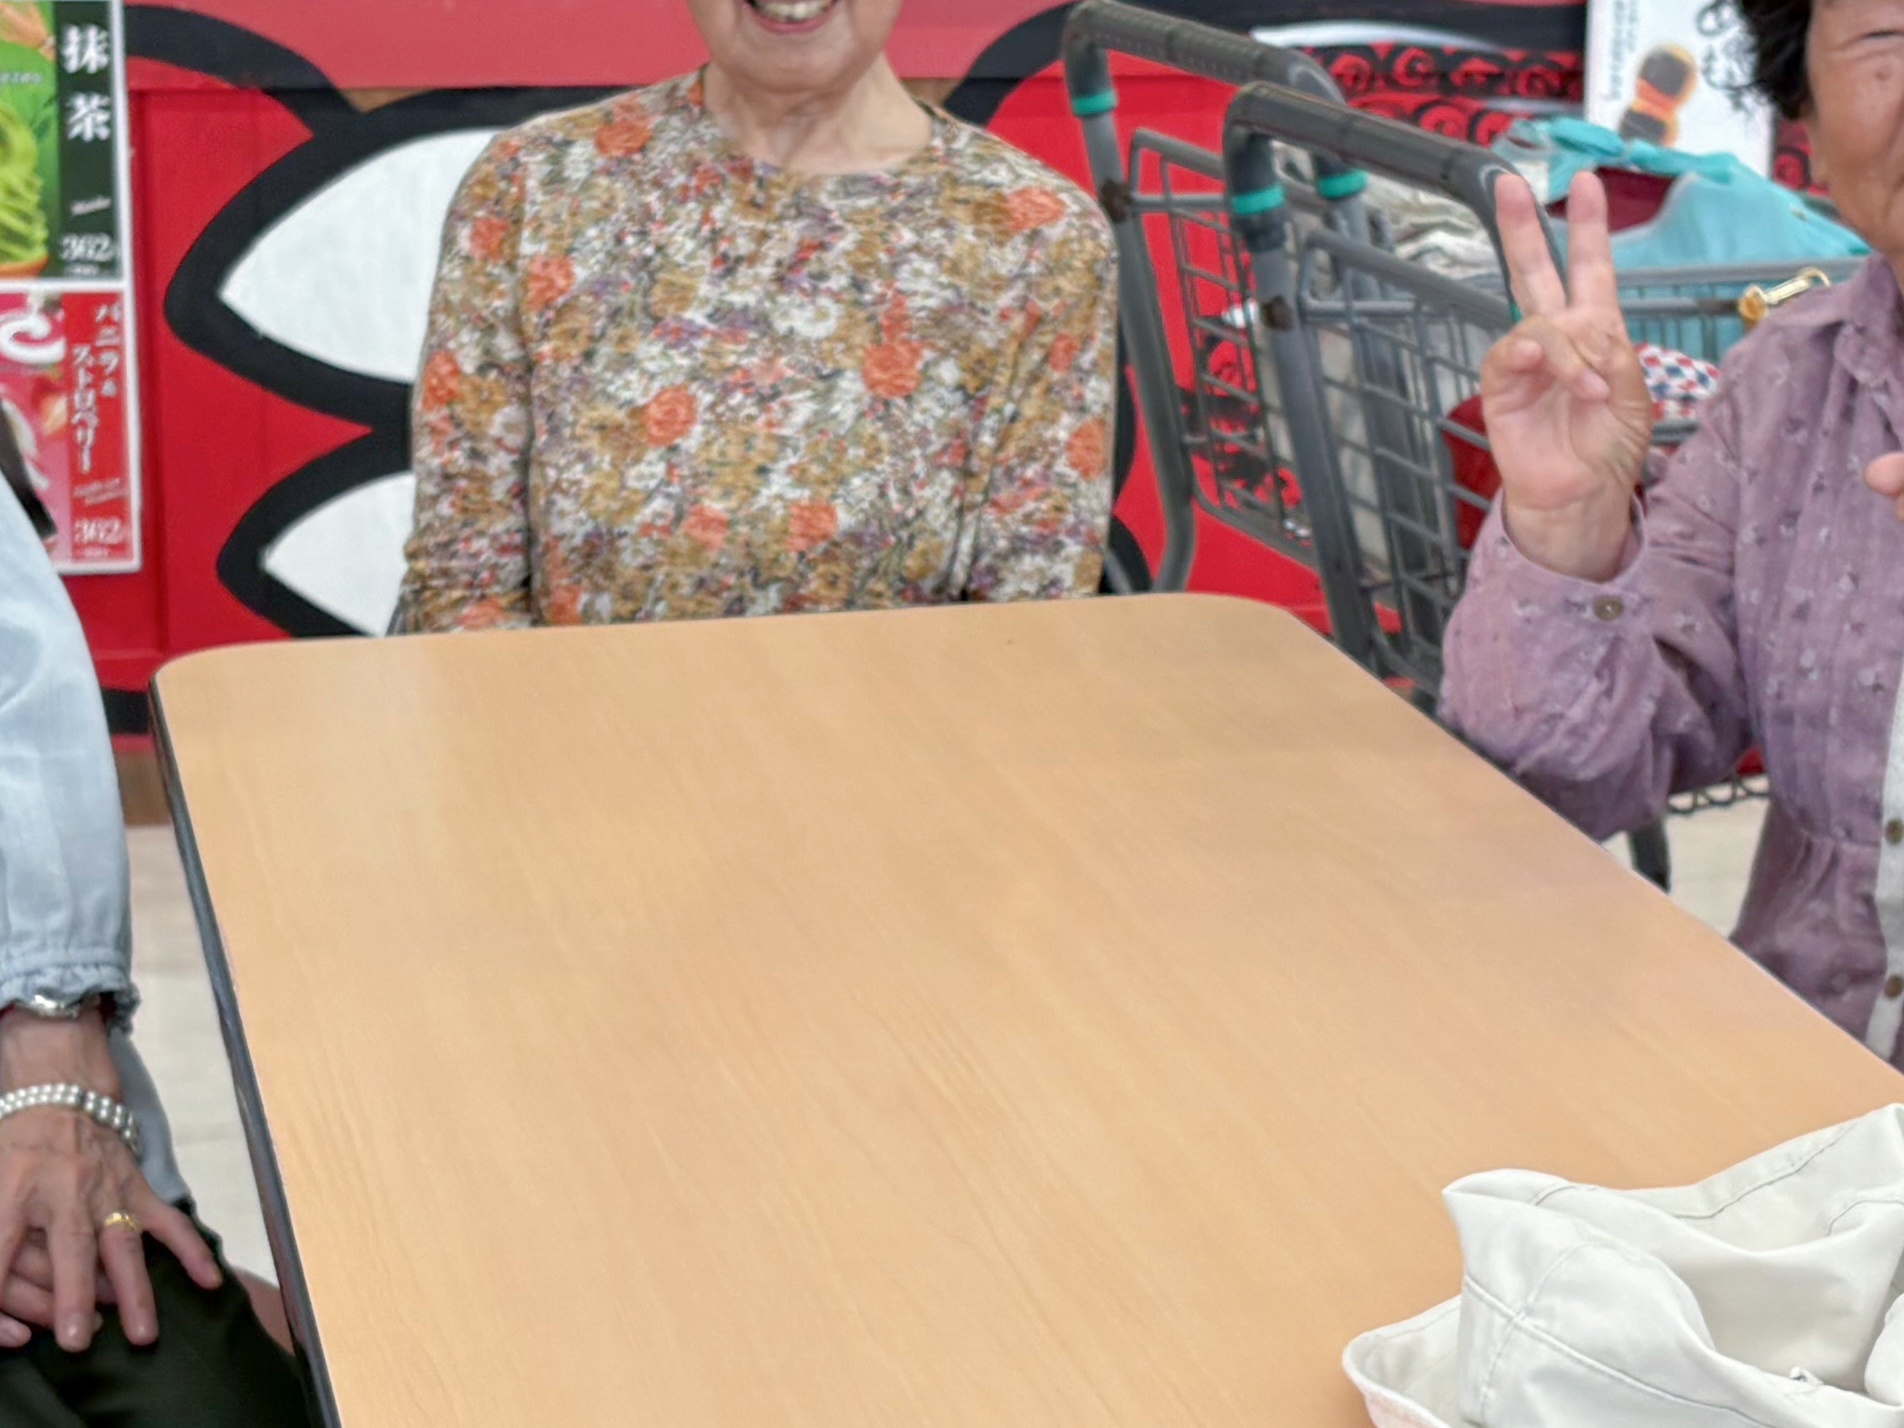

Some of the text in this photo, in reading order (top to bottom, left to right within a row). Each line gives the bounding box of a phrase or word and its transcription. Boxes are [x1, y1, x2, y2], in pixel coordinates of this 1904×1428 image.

[62, 24, 112, 142] 抹茶
[71, 344, 100, 474] ストロベリー
